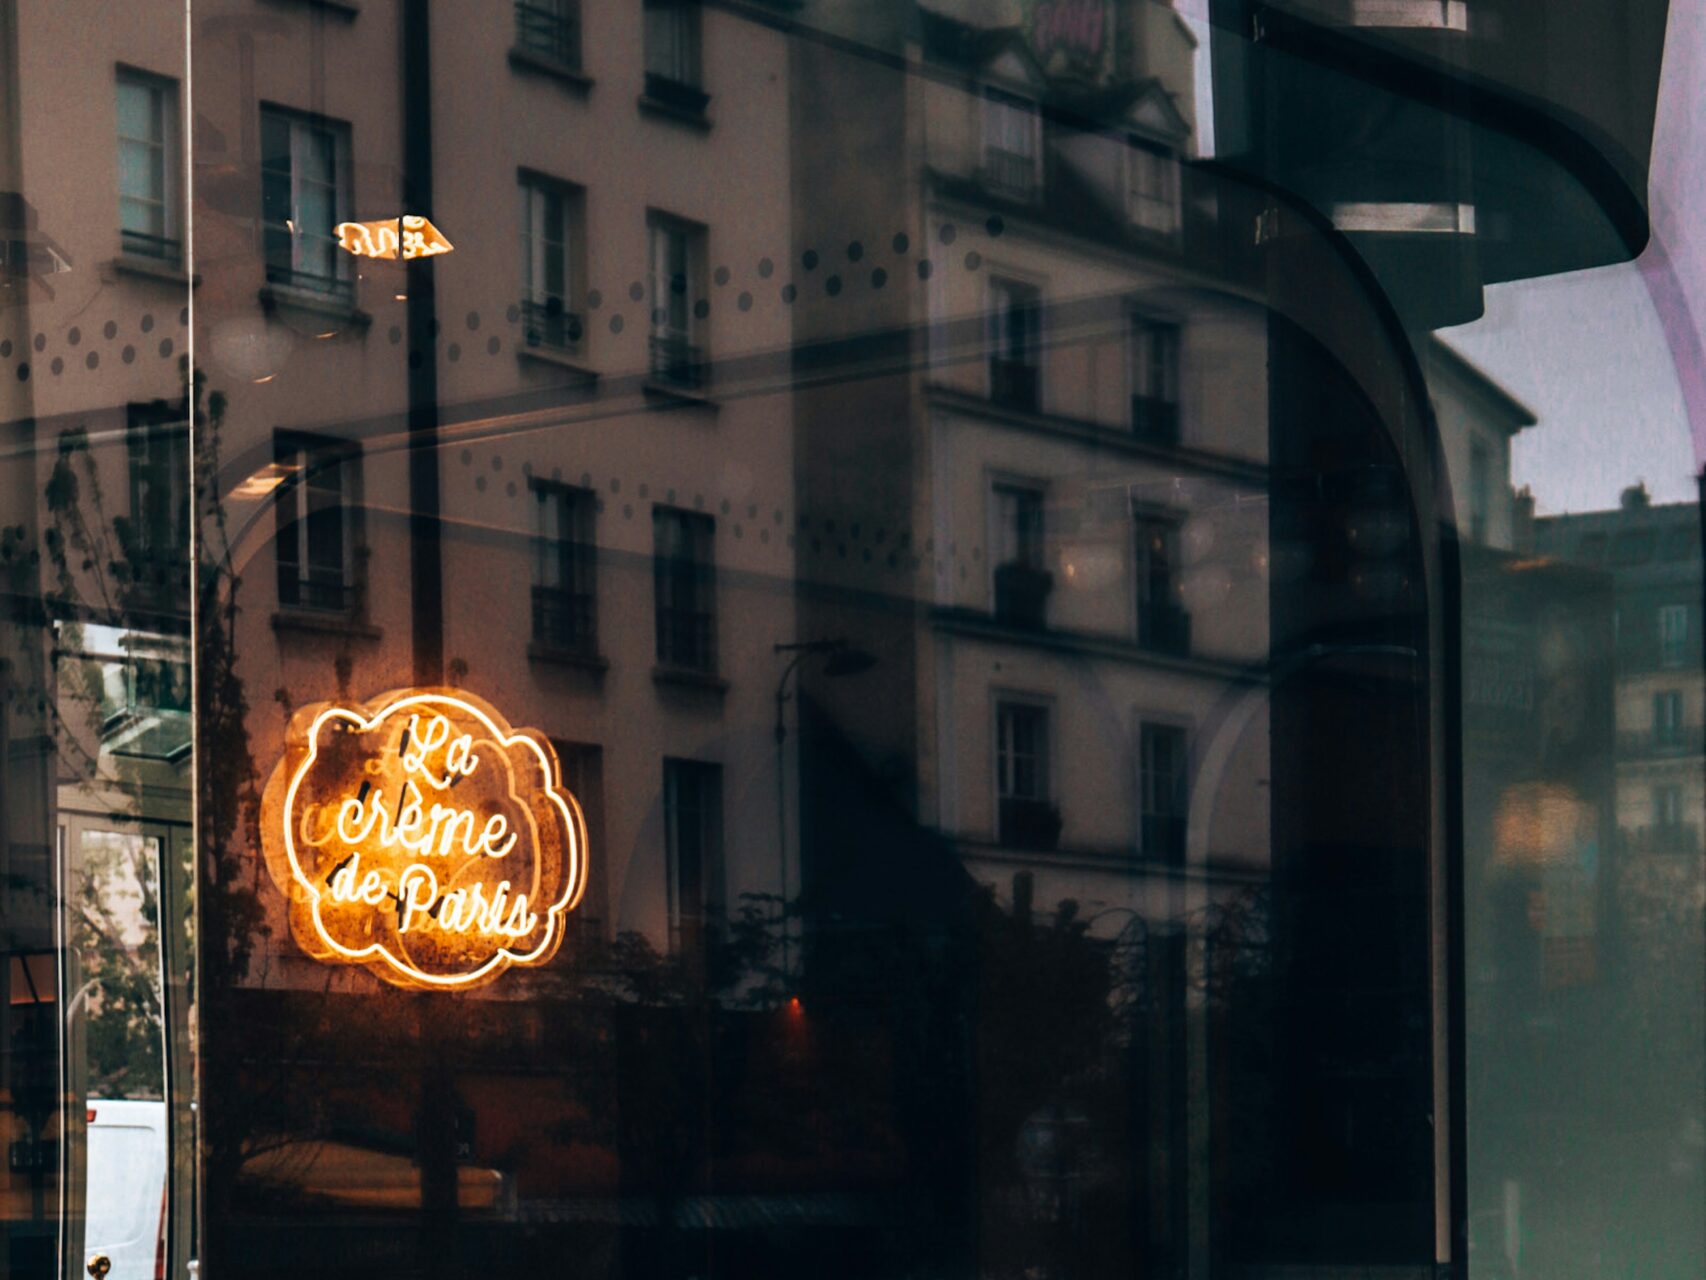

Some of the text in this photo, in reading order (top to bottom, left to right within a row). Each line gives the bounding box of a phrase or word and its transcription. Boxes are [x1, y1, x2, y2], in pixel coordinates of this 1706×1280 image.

[403, 714, 479, 790] La
[337, 779, 517, 858] crème
[332, 851, 537, 937] de Paris
